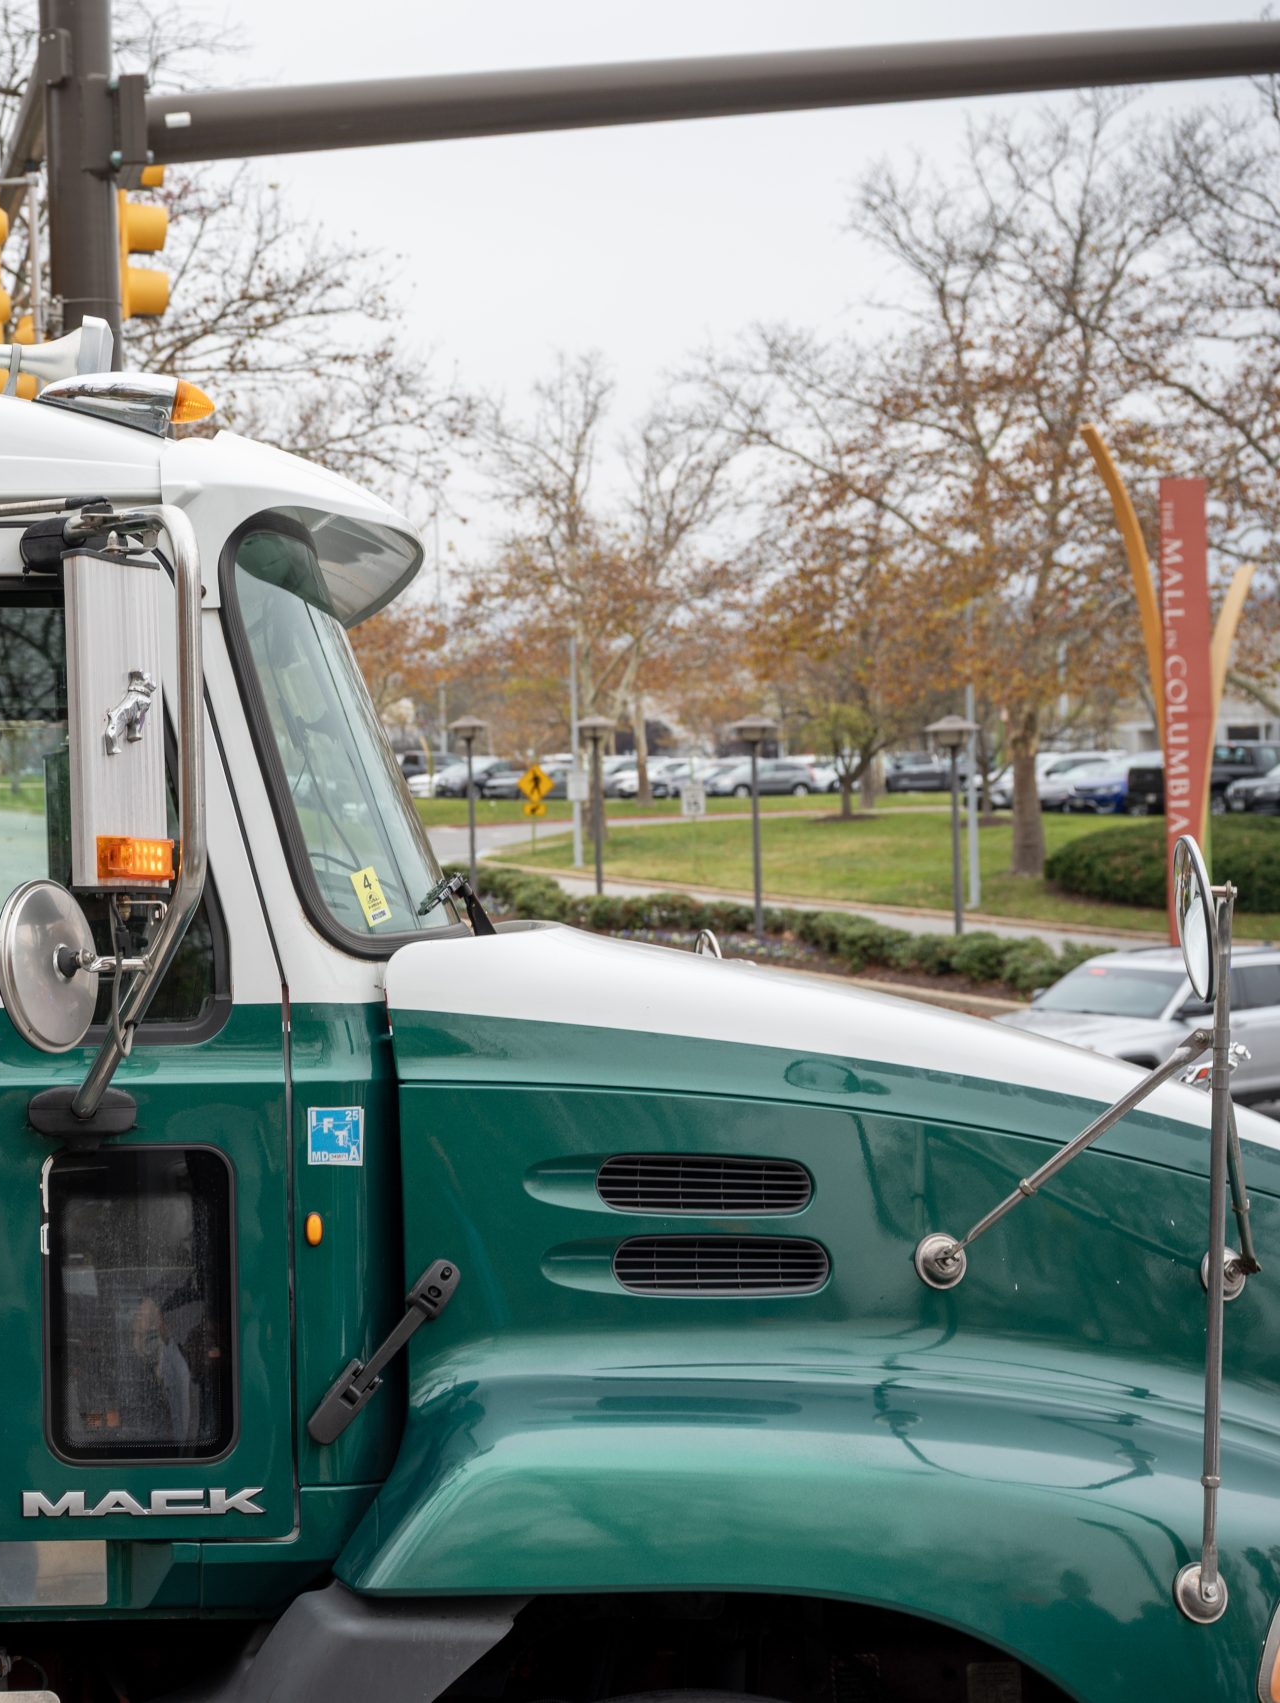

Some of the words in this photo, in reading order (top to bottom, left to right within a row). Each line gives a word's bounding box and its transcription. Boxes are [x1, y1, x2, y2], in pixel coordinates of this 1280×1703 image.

[1163, 538, 1185, 627] MALL
[1165, 655, 1190, 832] COLUMBIA
[363, 873, 372, 890] 4
[345, 1110, 359, 1121] 25
[312, 1152, 329, 1162] MD
[22, 1488, 267, 1517] MACK
